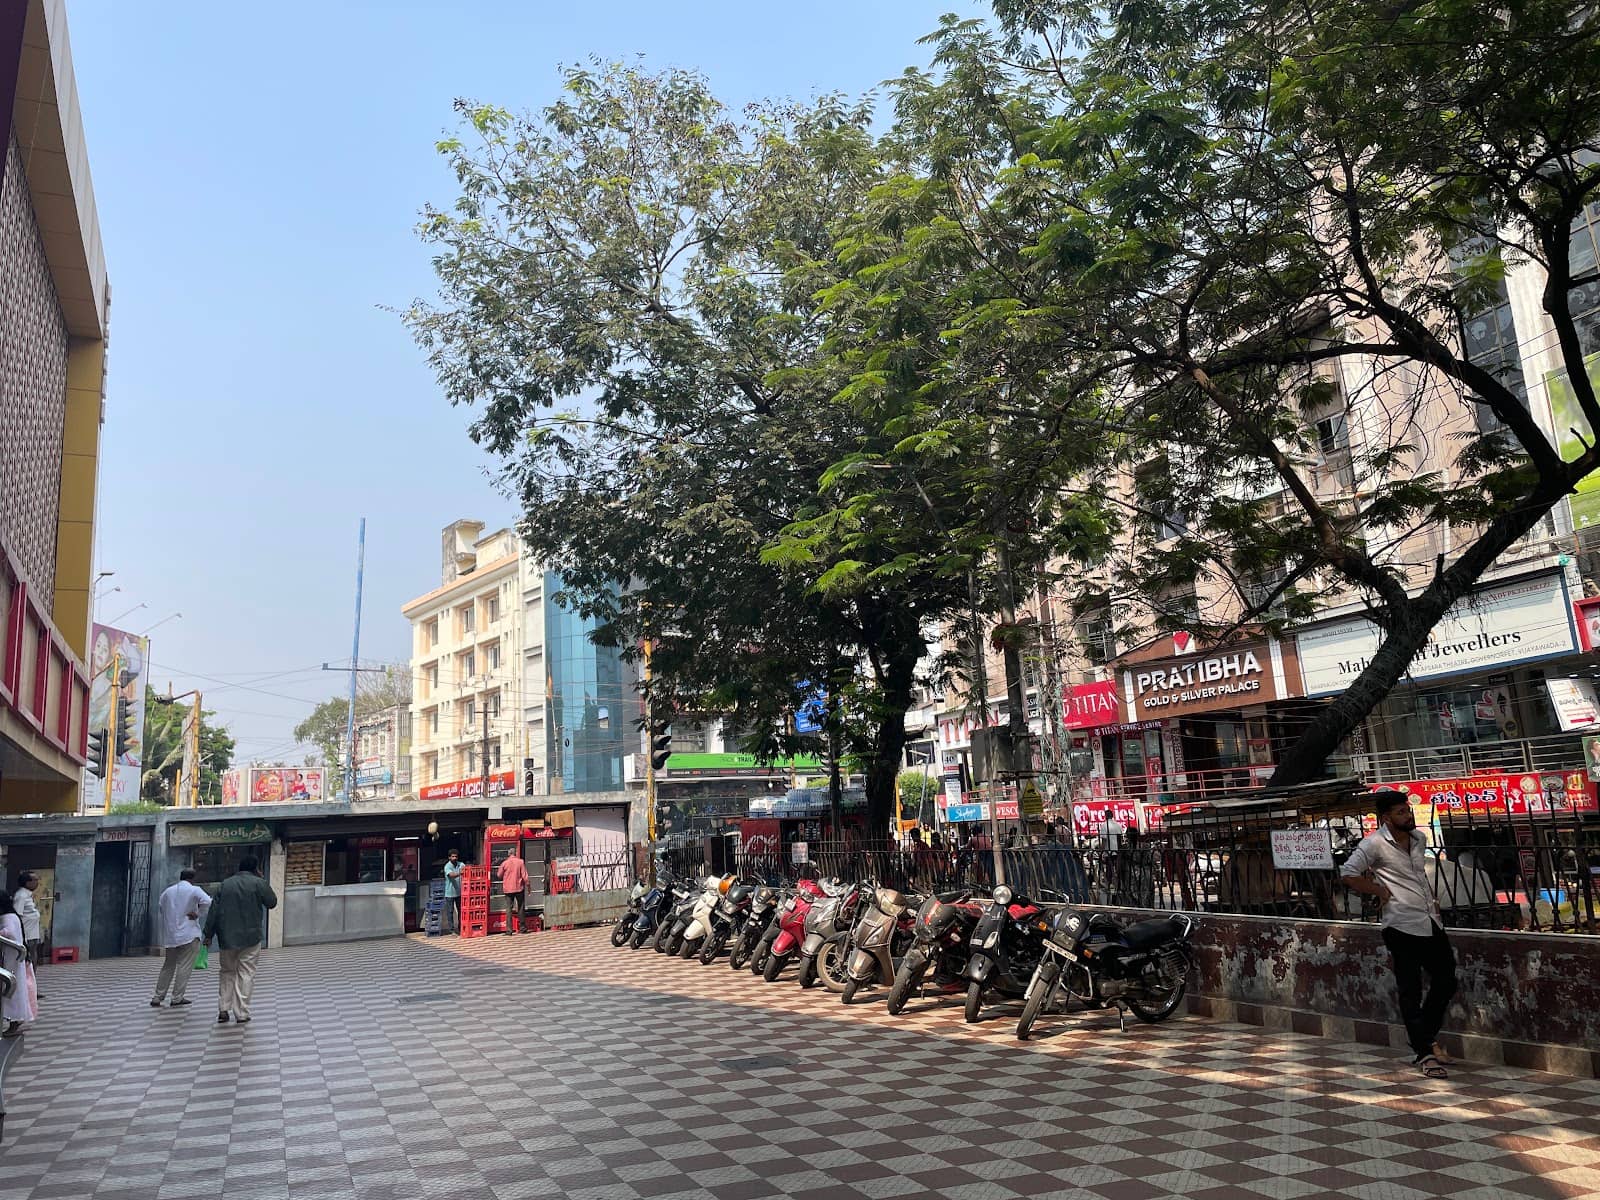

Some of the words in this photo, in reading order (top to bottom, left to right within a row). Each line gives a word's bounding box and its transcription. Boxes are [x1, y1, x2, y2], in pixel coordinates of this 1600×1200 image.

[1432, 631, 1522, 658] Jewellers
[1137, 651, 1264, 694] PRATIBHA
[1072, 691, 1118, 715] TITAN
[1143, 696, 1170, 708] GOLD
[1172, 694, 1179, 703] &
[1181, 687, 1217, 702] SILVER
[1218, 679, 1260, 695] PALACE
[1422, 783, 1456, 792] TASTY
[1460, 781, 1500, 790] TOUCH
